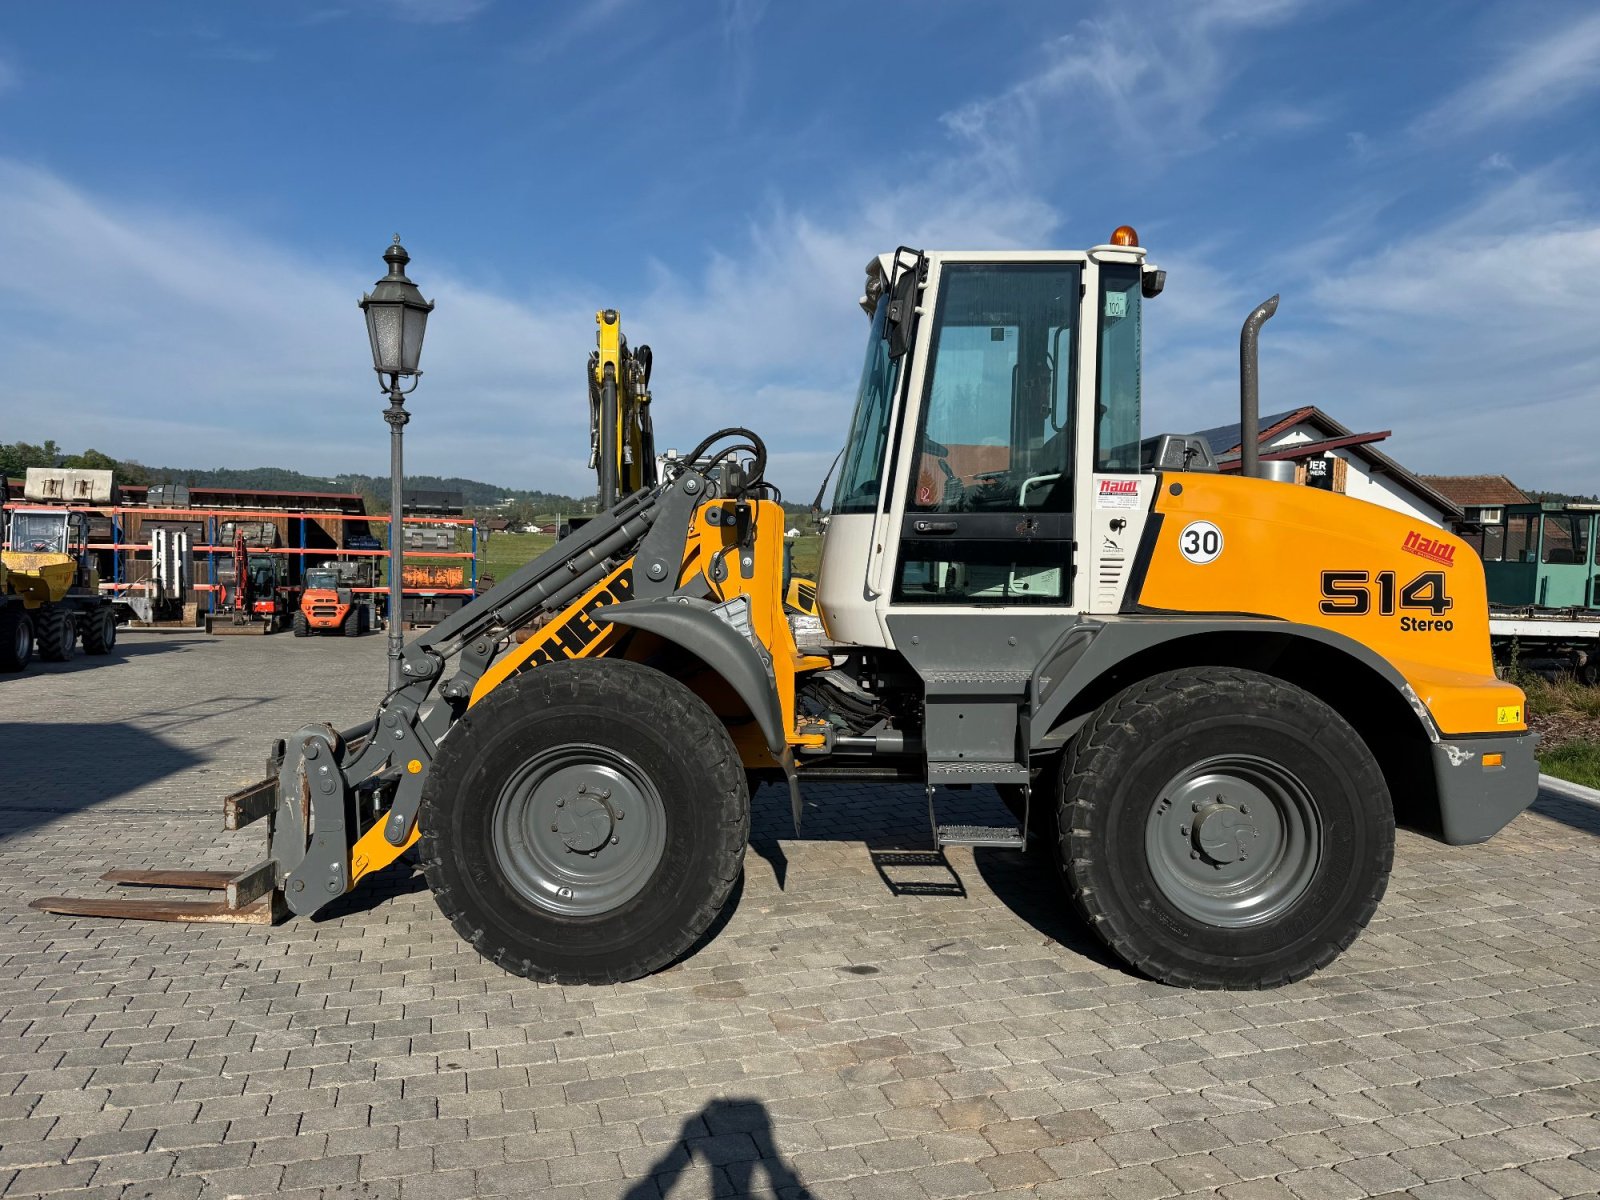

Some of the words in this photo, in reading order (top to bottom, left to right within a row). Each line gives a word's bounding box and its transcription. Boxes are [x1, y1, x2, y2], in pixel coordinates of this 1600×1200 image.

[1184, 530, 1219, 555] 30
[1318, 570, 1454, 616] 514
[1400, 617, 1454, 632] Stereo
